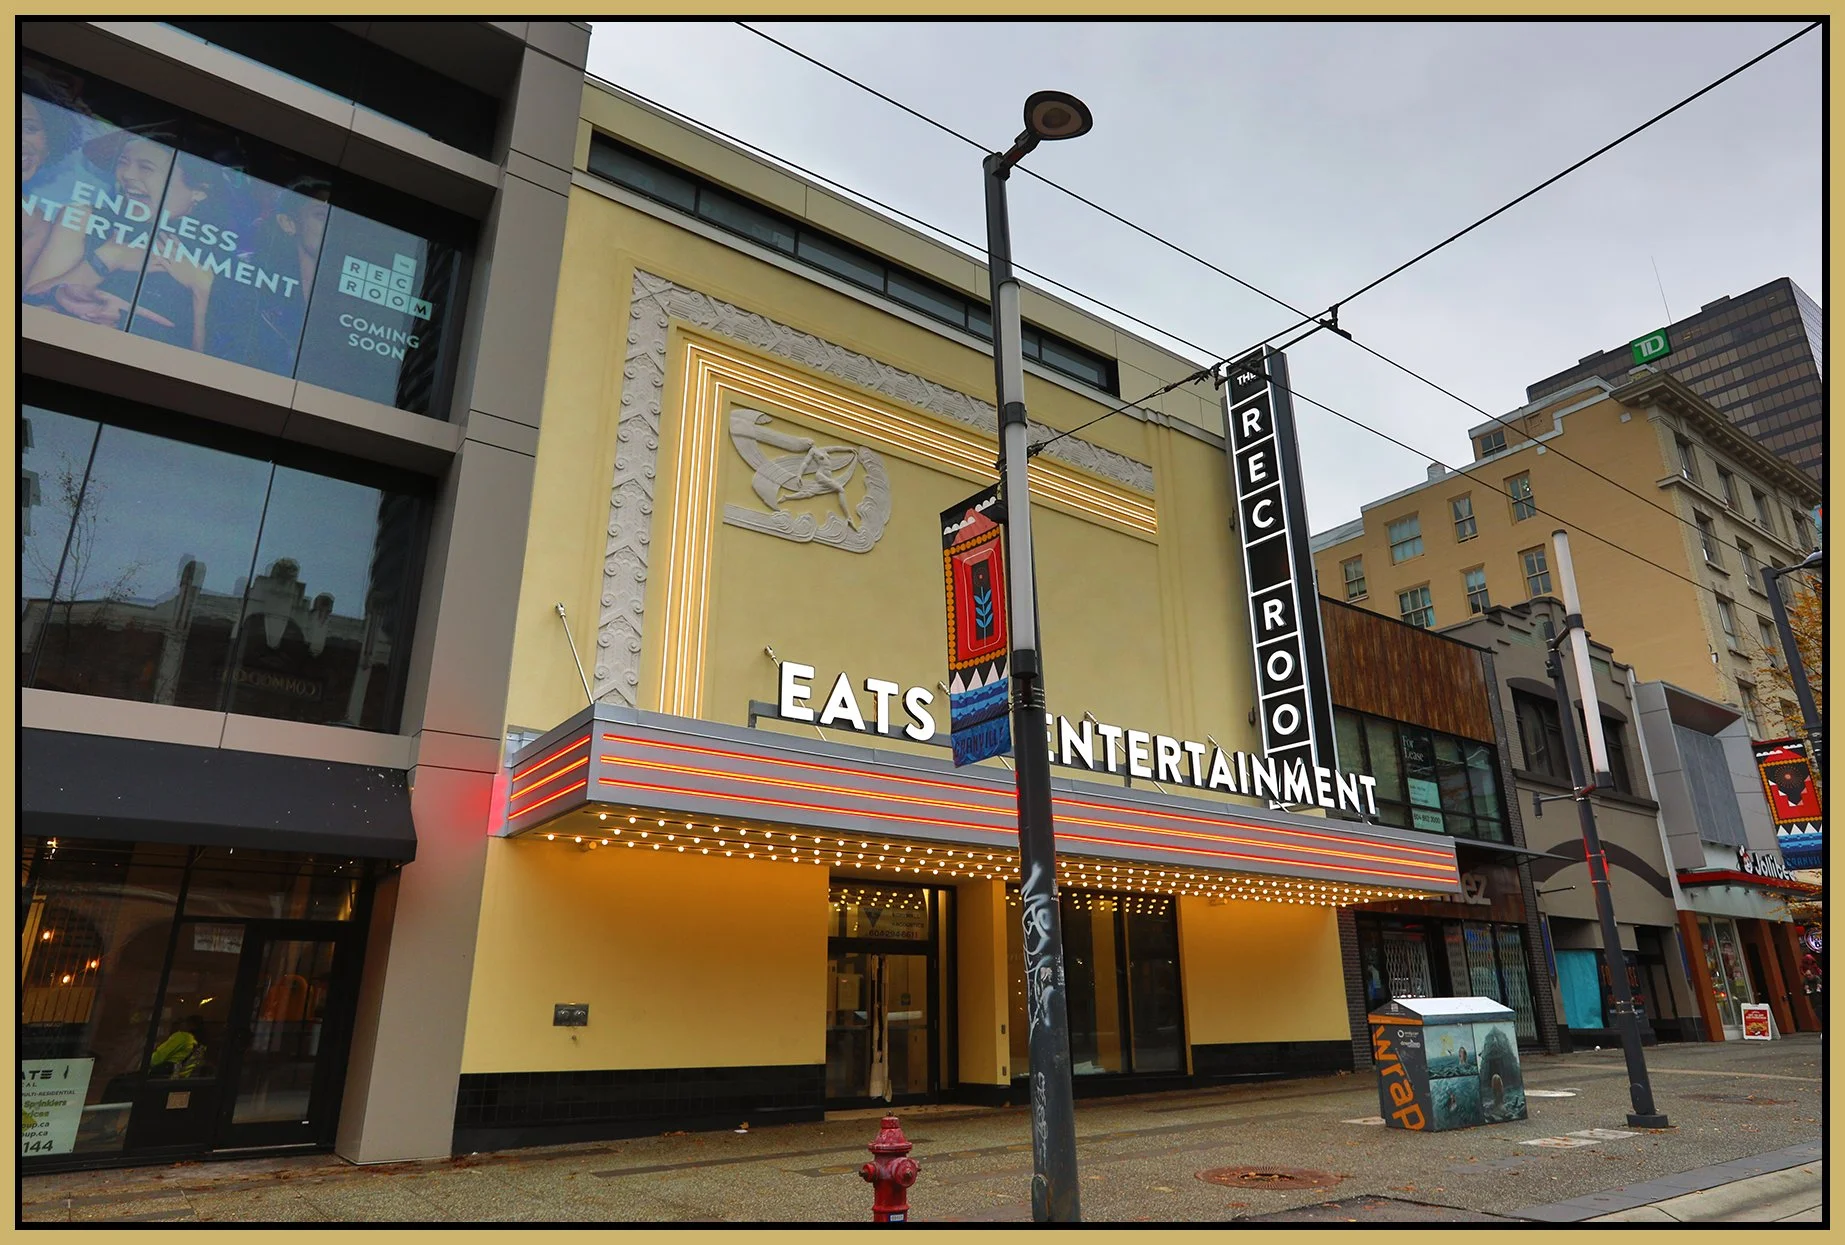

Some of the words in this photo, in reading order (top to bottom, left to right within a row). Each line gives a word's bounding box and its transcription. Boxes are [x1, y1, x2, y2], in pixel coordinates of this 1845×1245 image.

[349, 262, 407, 289] REC
[346, 280, 427, 316] ROOM
[339, 314, 420, 349] COMING
[348, 333, 405, 361] SOON
[1634, 335, 1664, 357] TD
[1241, 405, 1276, 531] REC
[779, 661, 936, 742] EATS
[1402, 735, 1414, 748] For
[1403, 747, 1424, 762] Lease
[1372, 1025, 1425, 1131] wrap
[24, 1099, 67, 1110] Sprinklers
[23, 1140, 53, 1153] 144
